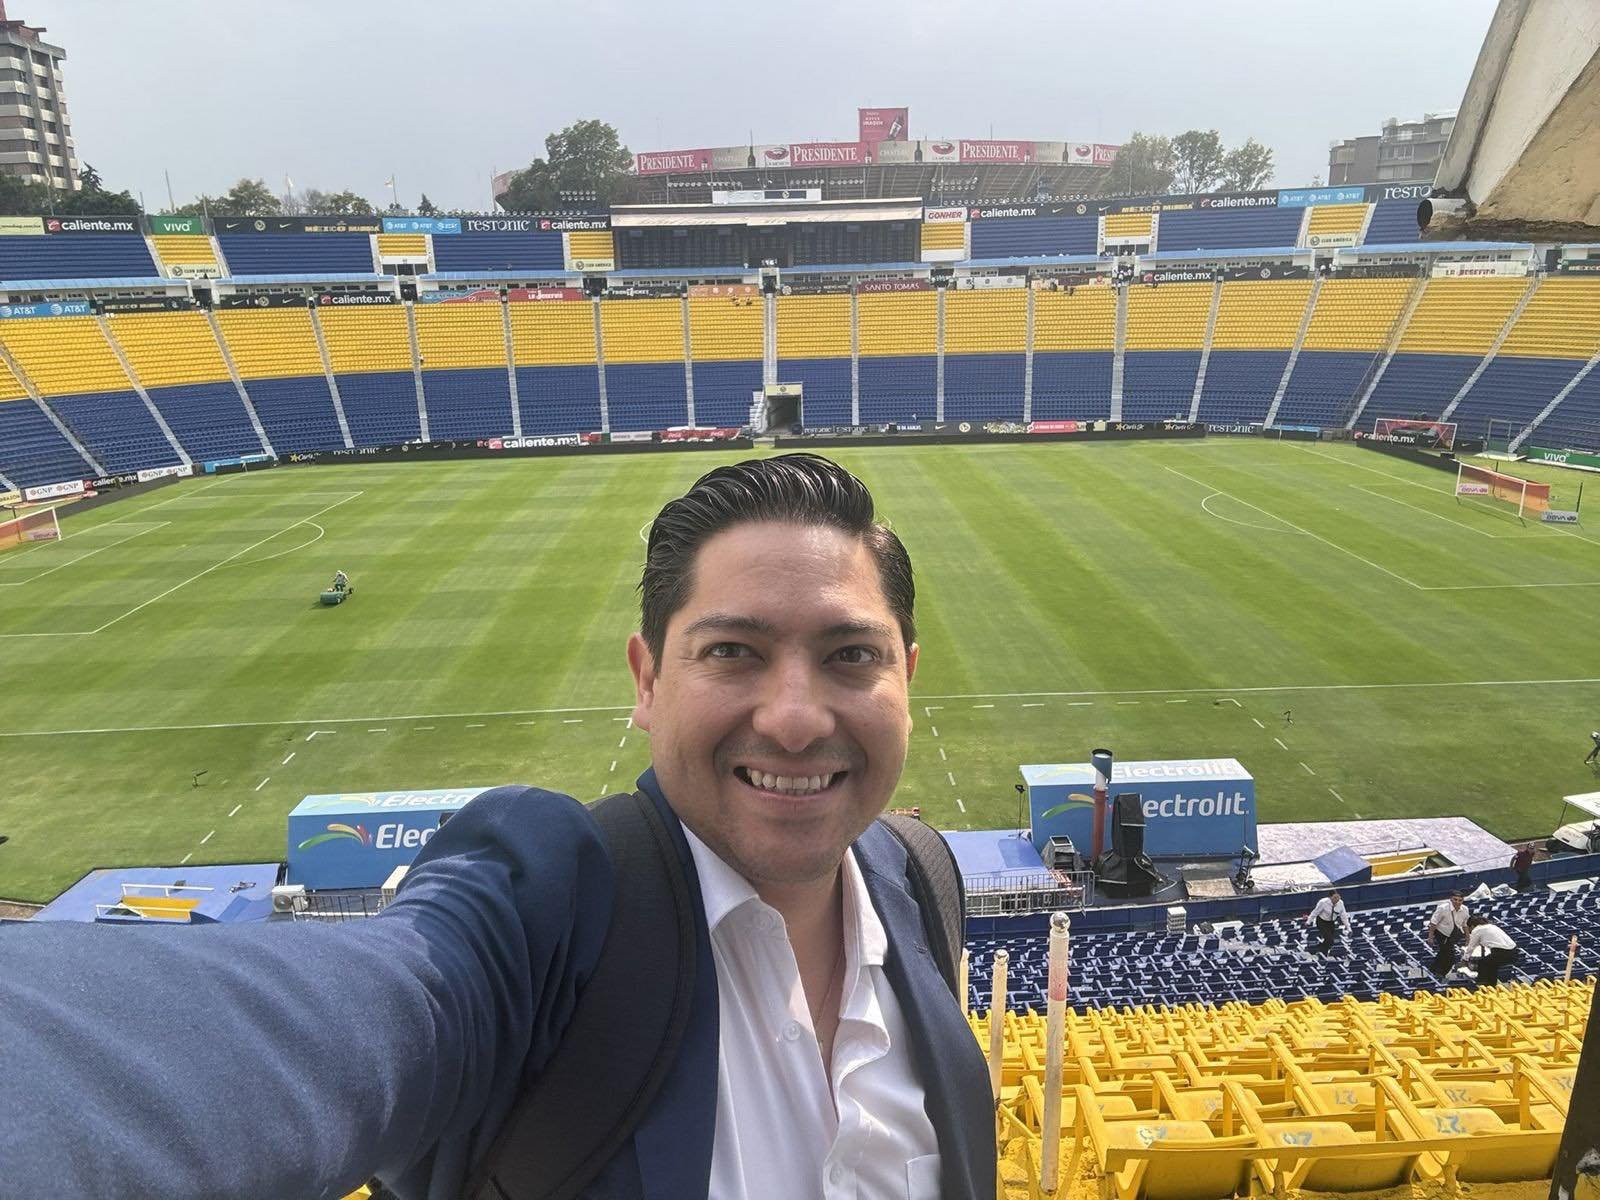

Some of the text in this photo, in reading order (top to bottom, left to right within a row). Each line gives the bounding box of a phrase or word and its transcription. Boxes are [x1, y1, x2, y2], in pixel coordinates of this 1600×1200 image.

[793, 145, 857, 162] PRESIDENTE
[963, 142, 1018, 159] PRESIDENTE
[640, 153, 695, 169] PRESIDENTE
[1211, 196, 1277, 209] caliente.mx
[928, 211, 963, 220] GONHER
[981, 208, 1036, 219] caliente.mx
[61, 219, 133, 231] caliente.mx
[551, 219, 607, 230] caliente.mx
[1154, 271, 1212, 281] caliente.mx
[332, 294, 391, 304] caliente.mx
[14, 305, 86, 315] AT&T AT&T
[503, 436, 578, 449] caliente.mx
[1363, 433, 1415, 444] caliente.mx
[63, 482, 79, 490] GNP
[92, 473, 138, 487] caliene.mx
[1112, 759, 1235, 778] Electrolit
[1140, 791, 1246, 818] ectrolit
